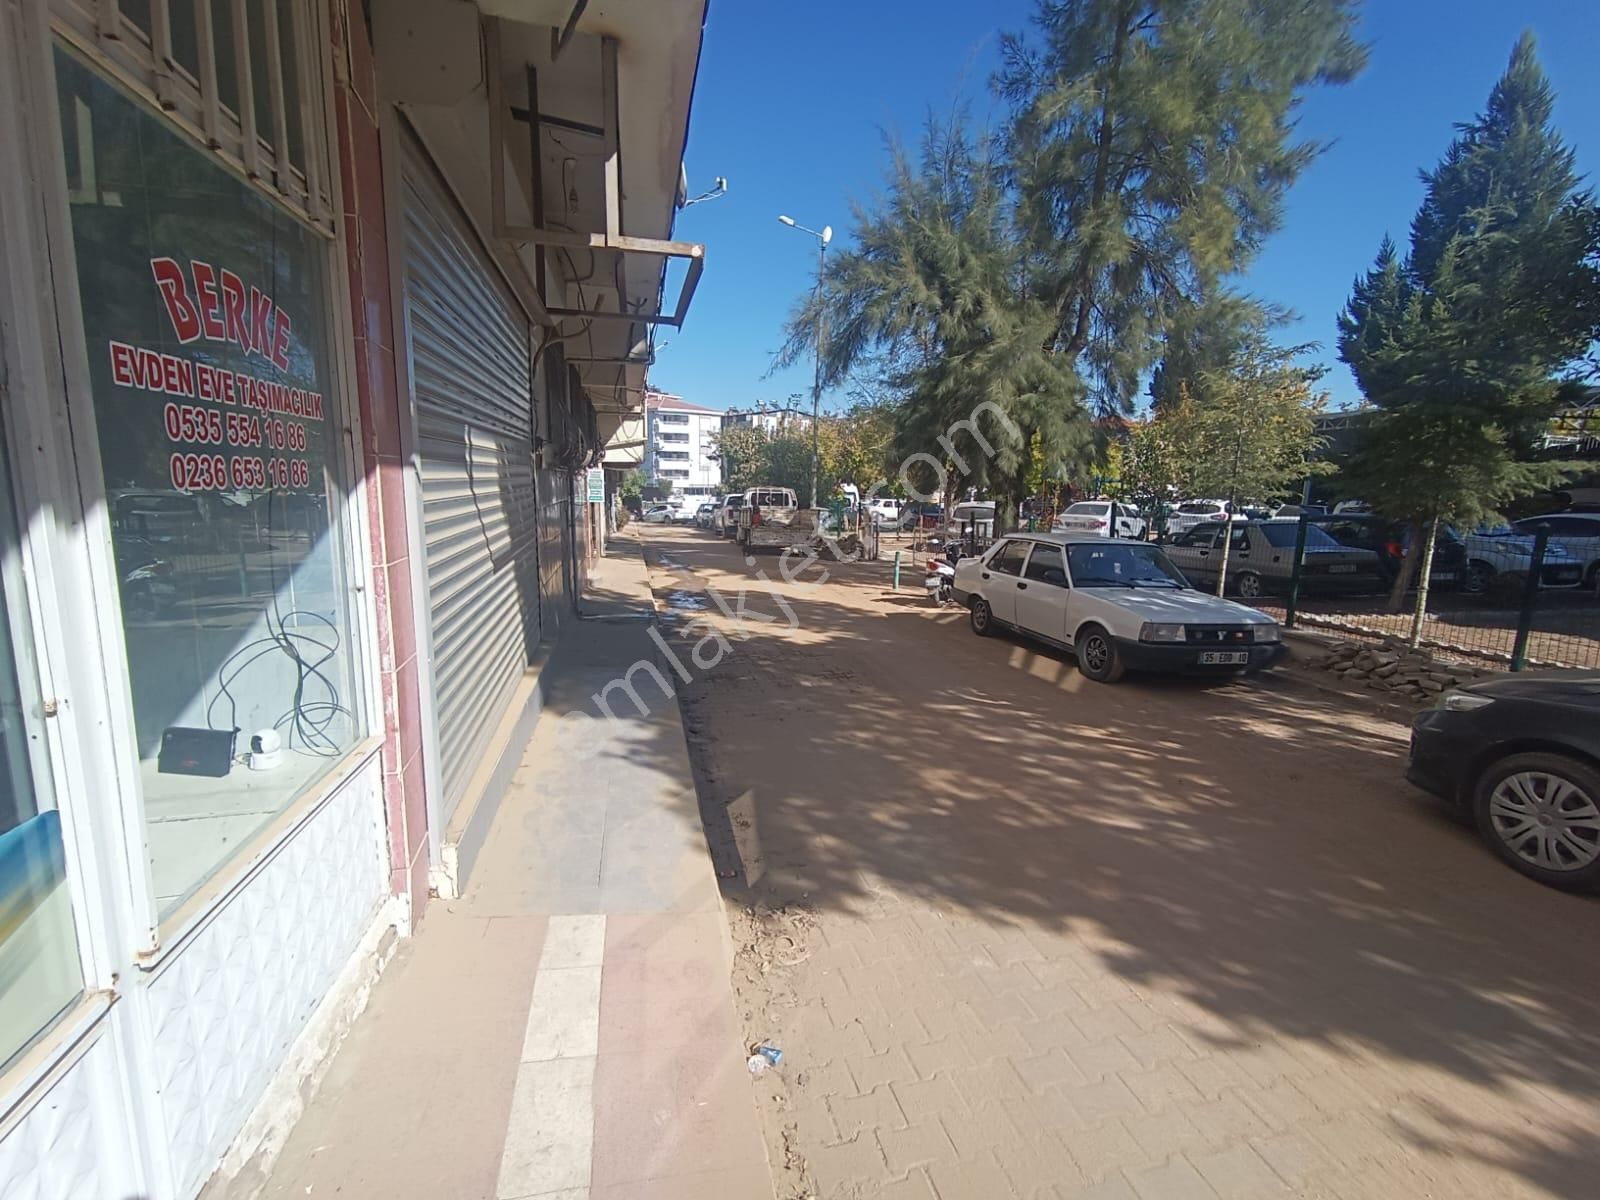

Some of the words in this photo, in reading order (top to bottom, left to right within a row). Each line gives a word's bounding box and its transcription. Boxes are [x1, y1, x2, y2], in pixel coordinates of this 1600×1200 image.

[151, 257, 291, 373] BERKE
[110, 340, 194, 398] EVDEN
[196, 363, 236, 405] EVE
[236, 374, 324, 420] TAŞIMACILIK
[164, 402, 222, 445] 0535
[226, 413, 262, 448] 554
[264, 418, 285, 449] 16
[287, 421, 306, 451] 86
[170, 452, 226, 491] 0236
[231, 456, 265, 488] 653
[268, 456, 288, 488] 16
[290, 458, 309, 487] 86
